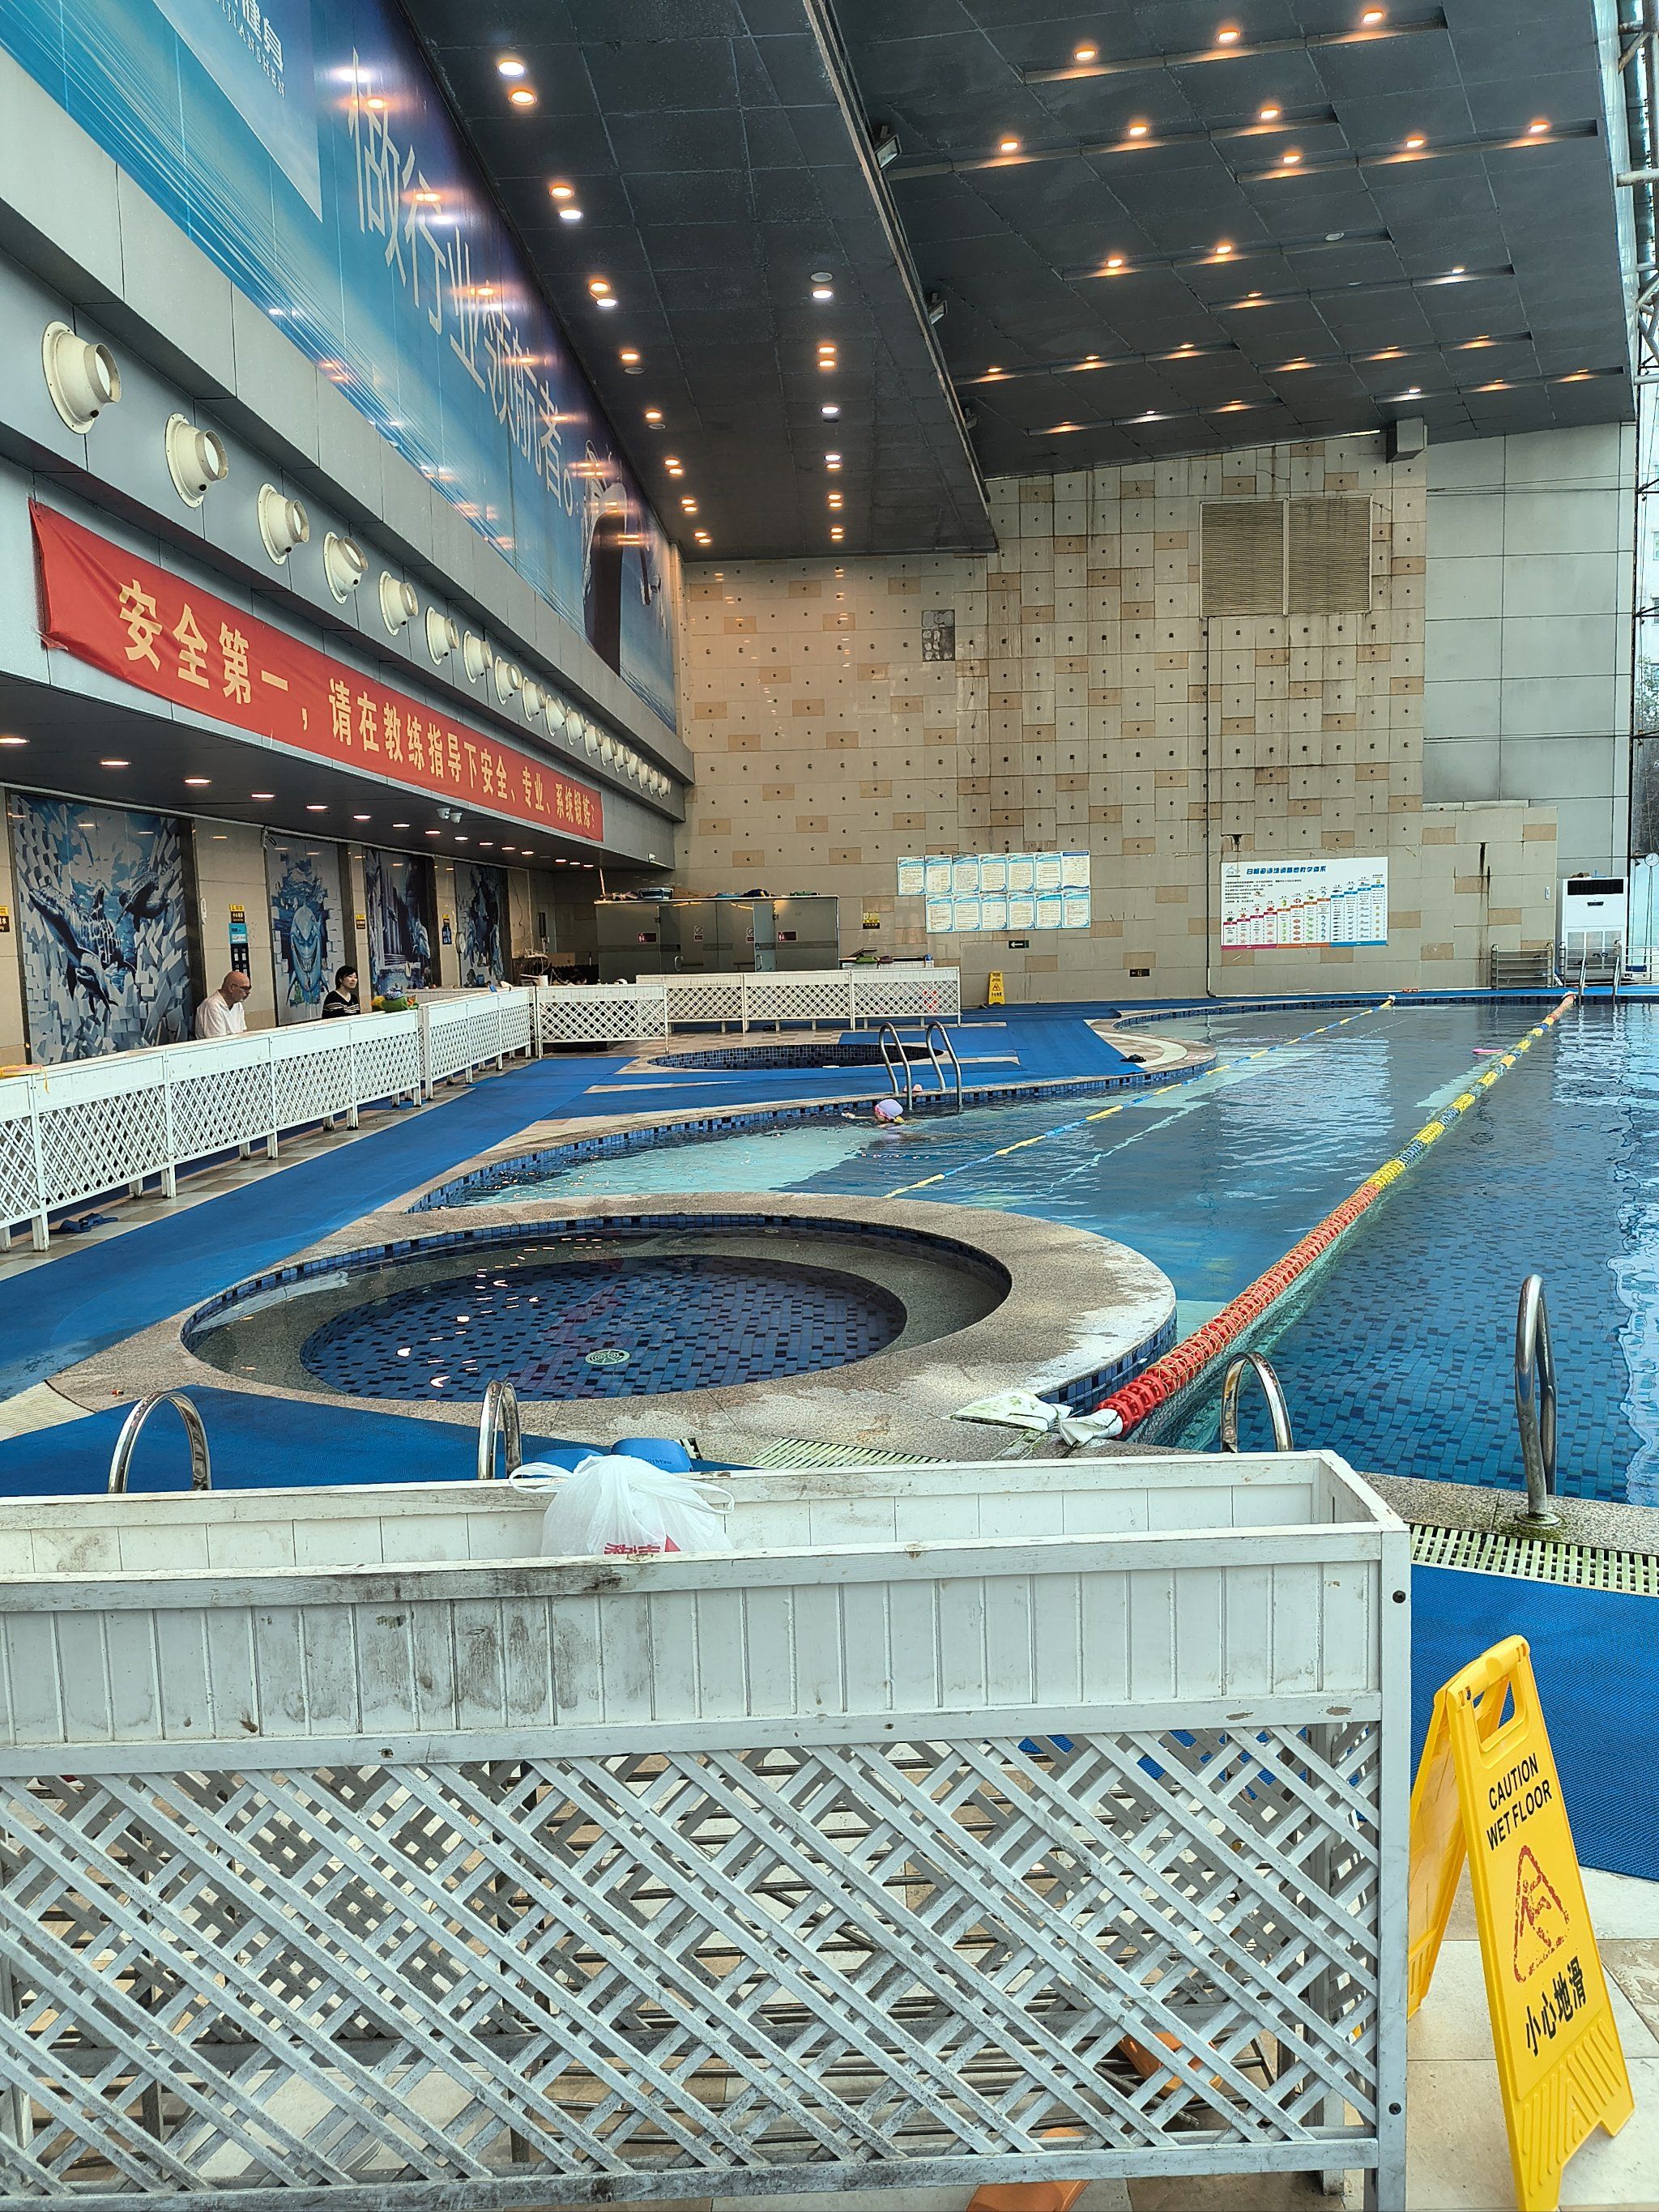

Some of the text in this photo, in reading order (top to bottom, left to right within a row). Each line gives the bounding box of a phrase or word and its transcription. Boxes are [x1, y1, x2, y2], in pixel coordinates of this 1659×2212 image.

[234, 0, 284, 74] 健身
[1486, 1779, 1553, 1852] WET FLOOR
[1489, 1753, 1538, 1810] CAUTION
[1526, 1955, 1586, 2057] 小心地滑
